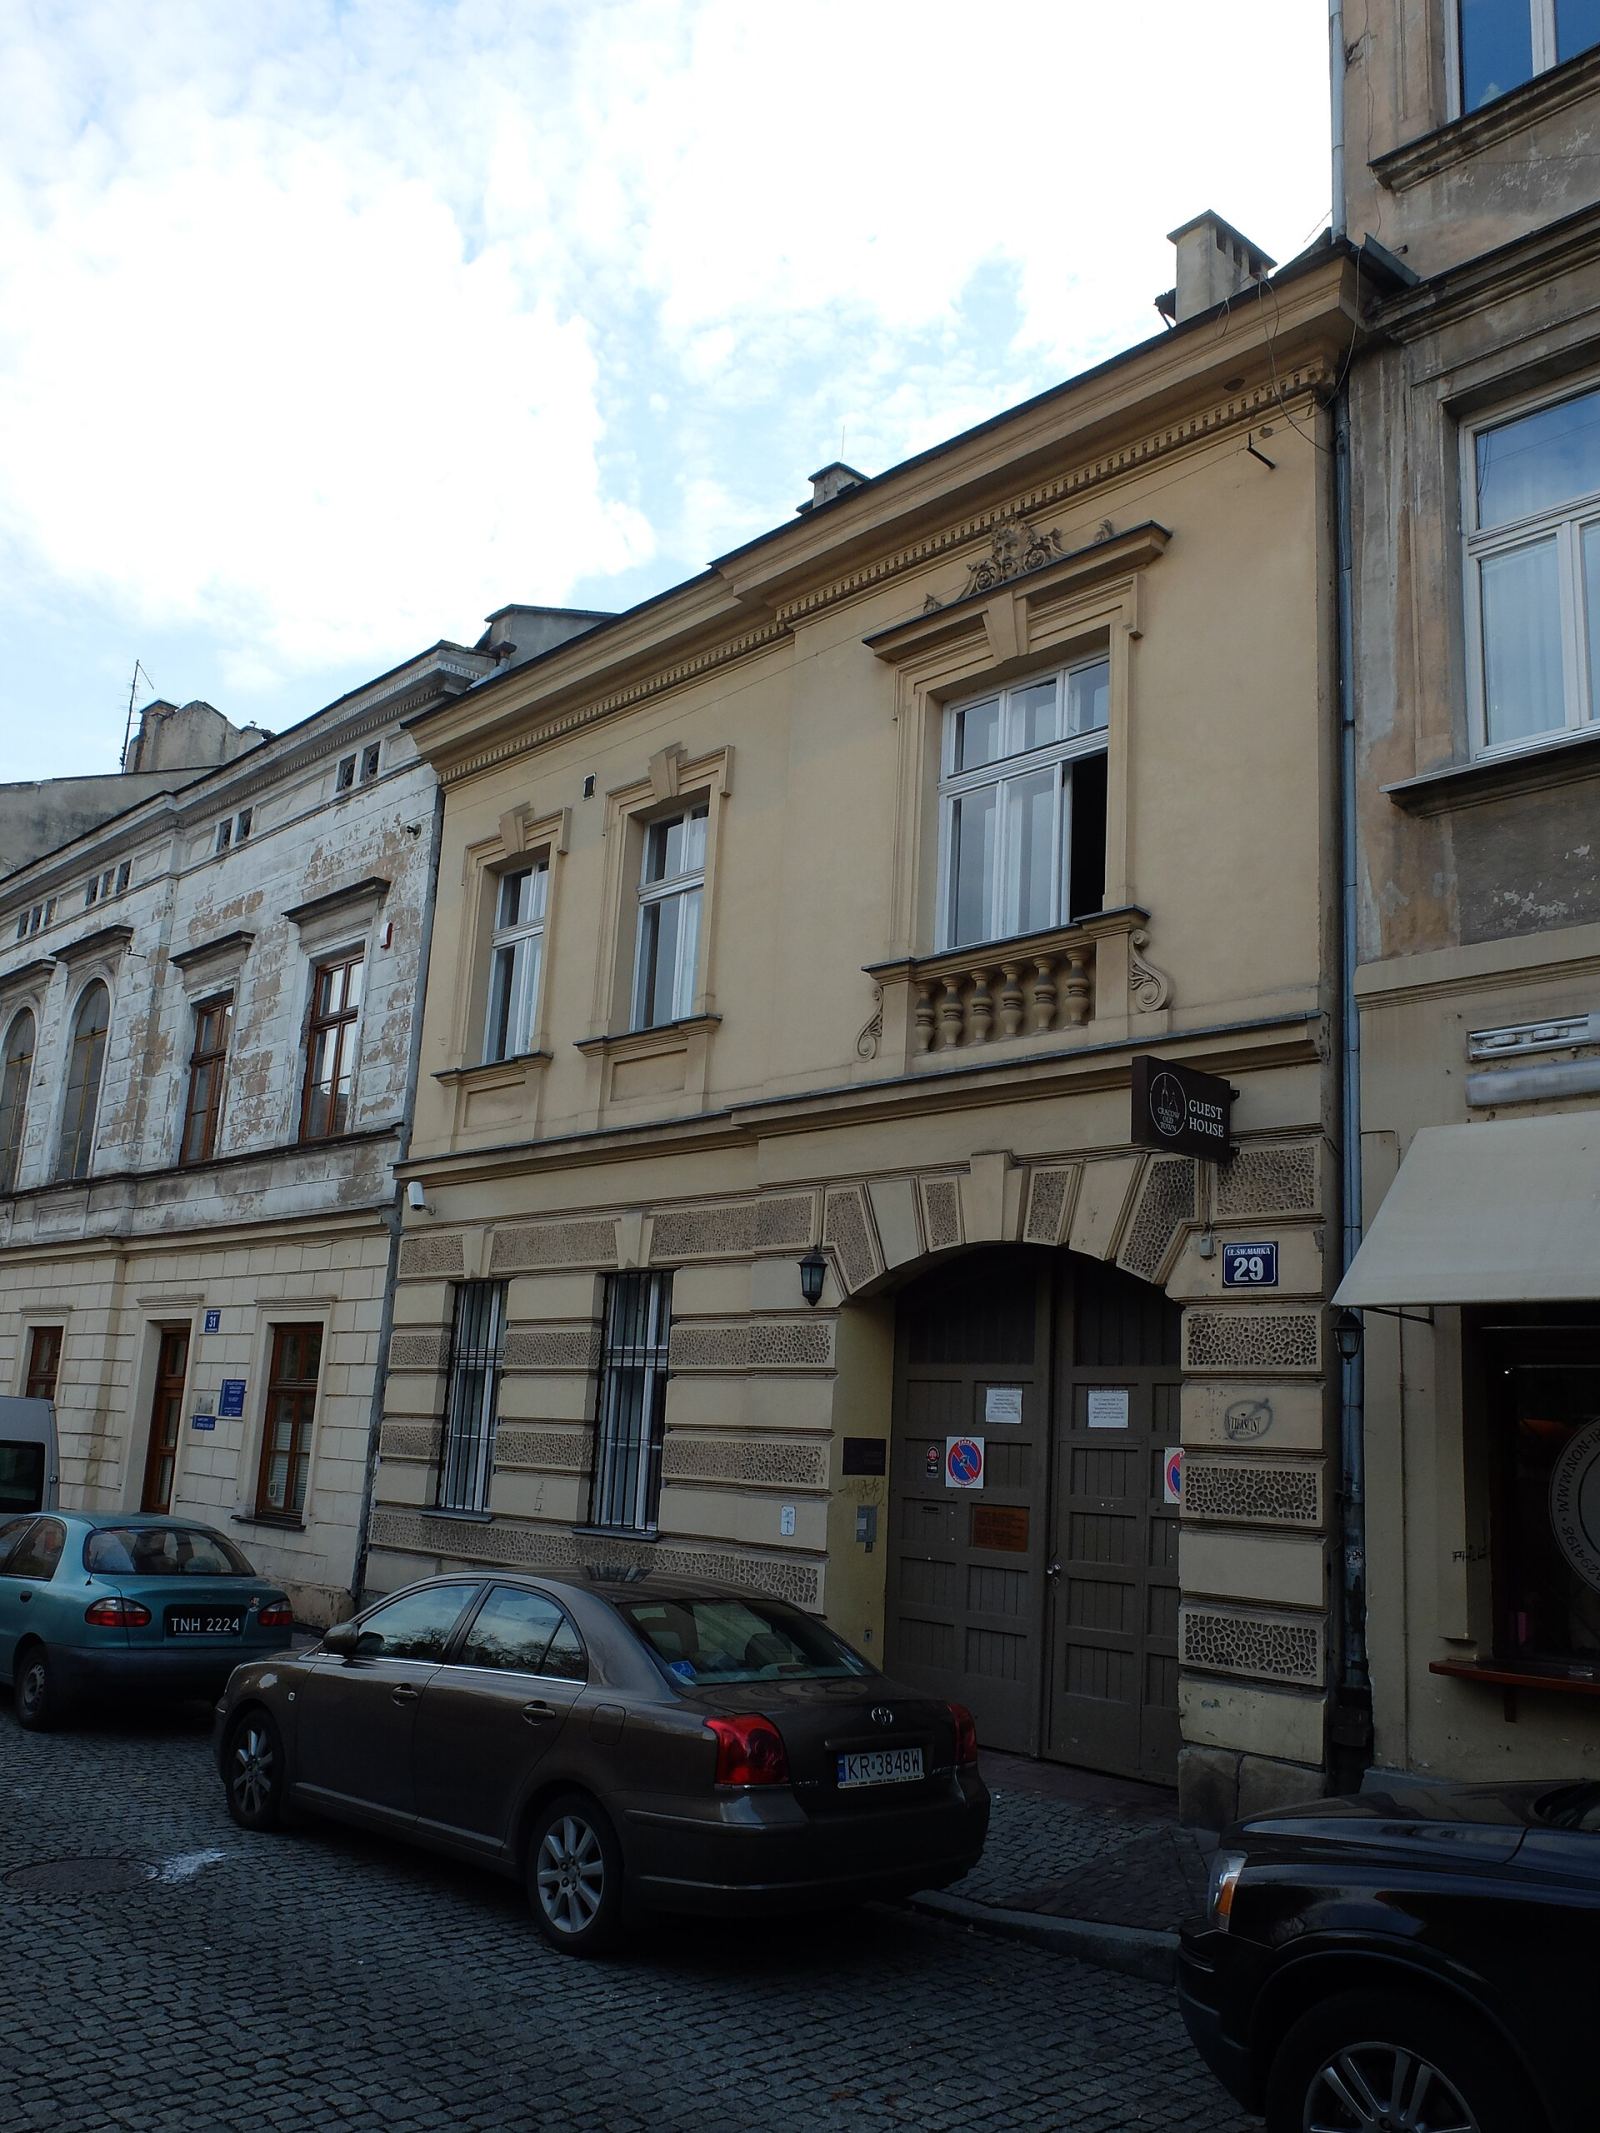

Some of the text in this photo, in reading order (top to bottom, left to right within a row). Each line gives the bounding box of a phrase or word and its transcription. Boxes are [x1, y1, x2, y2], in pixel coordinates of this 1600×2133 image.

[1188, 1099, 1223, 1120] GUEST
[1189, 1117, 1225, 1138] HOUSE
[1233, 1256, 1264, 1281] 29
[208, 1316, 217, 1328] 31
[171, 1617, 240, 1632] TNH 2224
[848, 1750, 920, 1779] KR 3848W
